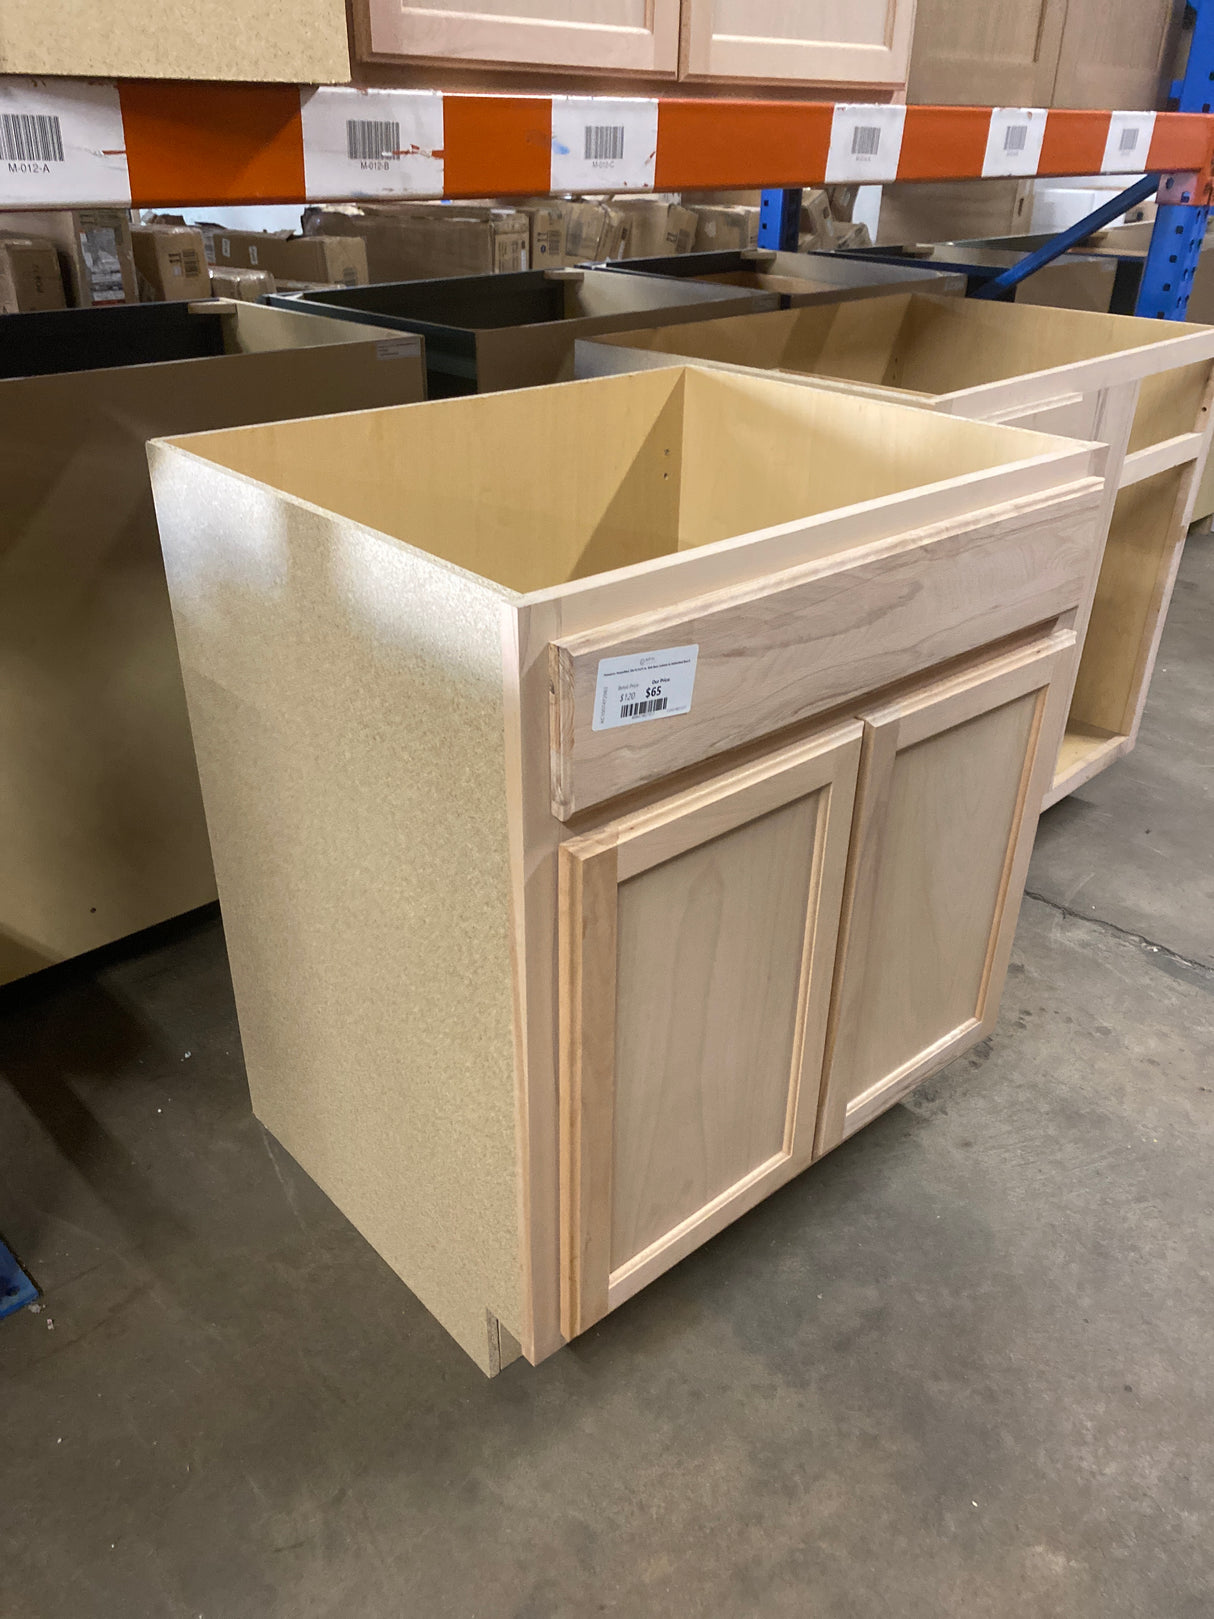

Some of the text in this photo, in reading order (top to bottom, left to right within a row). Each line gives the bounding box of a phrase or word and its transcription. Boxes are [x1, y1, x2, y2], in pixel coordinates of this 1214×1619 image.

[8, 162, 51, 174] M-012-A
[360, 161, 390, 171] M-012-B
[619, 691, 636, 703] $120
[645, 685, 662, 699] $65
